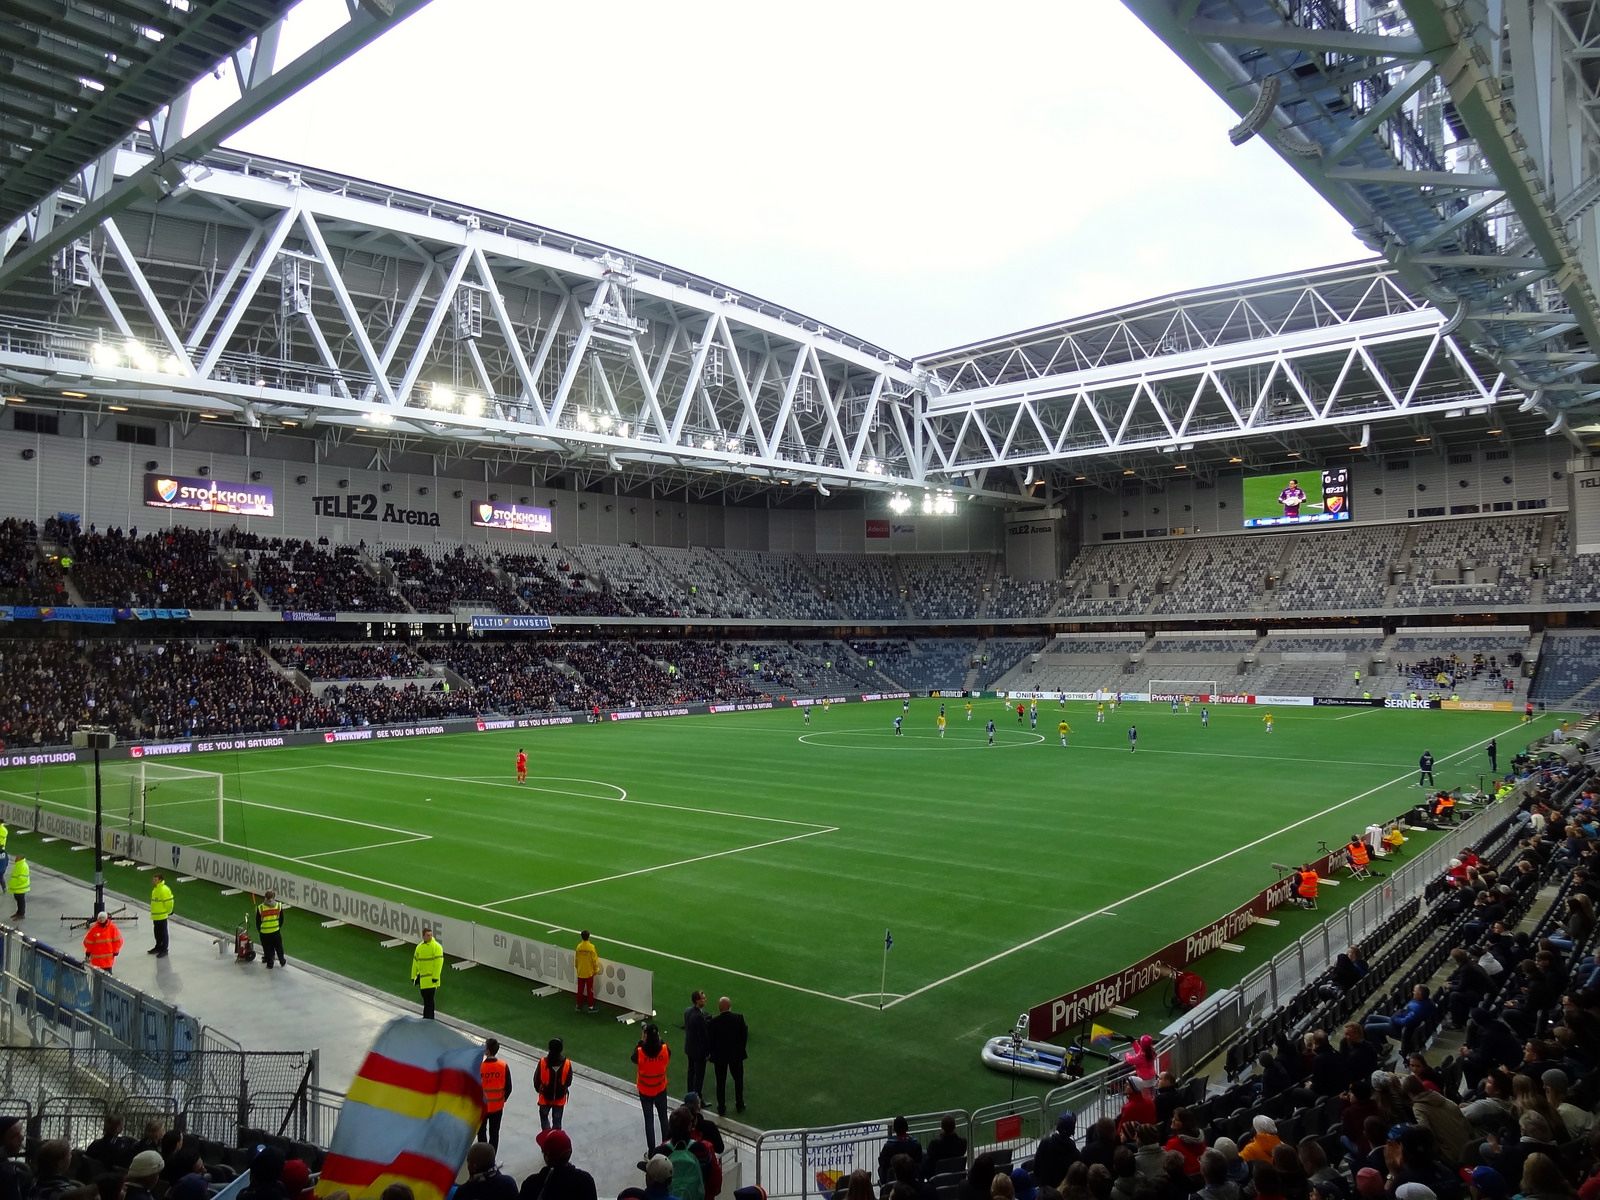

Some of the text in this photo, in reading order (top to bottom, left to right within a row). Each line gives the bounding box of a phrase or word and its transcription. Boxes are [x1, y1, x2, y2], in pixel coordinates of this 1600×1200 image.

[1580, 477, 1600, 488] TEL
[180, 487, 265, 505] STOCKHOLM
[312, 494, 440, 527] TELE2 Arena
[494, 510, 546, 523] STOCKHOLM
[1009, 525, 1051, 535] TELE2 Arena
[473, 618, 548, 627] ALLTID OAVSETT
[1384, 699, 1430, 709] SERNEKE
[377, 730, 389, 738] SEE
[391, 729, 403, 737] YOU
[405, 728, 414, 736] ON
[415, 726, 444, 735] SATURDA
[198, 743, 213, 752] SEE
[217, 741, 232, 750] YOU
[235, 740, 245, 749] ON
[248, 738, 283, 748] SATURDA
[12, 756, 26, 766] ON
[30, 752, 76, 763] SATURDA
[12, 807, 34, 828] DRYCK
[47, 815, 80, 839] GLOBENS
[195, 856, 209, 874] AV
[303, 882, 328, 910] FÖR
[1186, 908, 1253, 962] Prioritet Finans
[493, 934, 580, 985] en AREN
[1052, 960, 1160, 1032] Prioritet Finans
